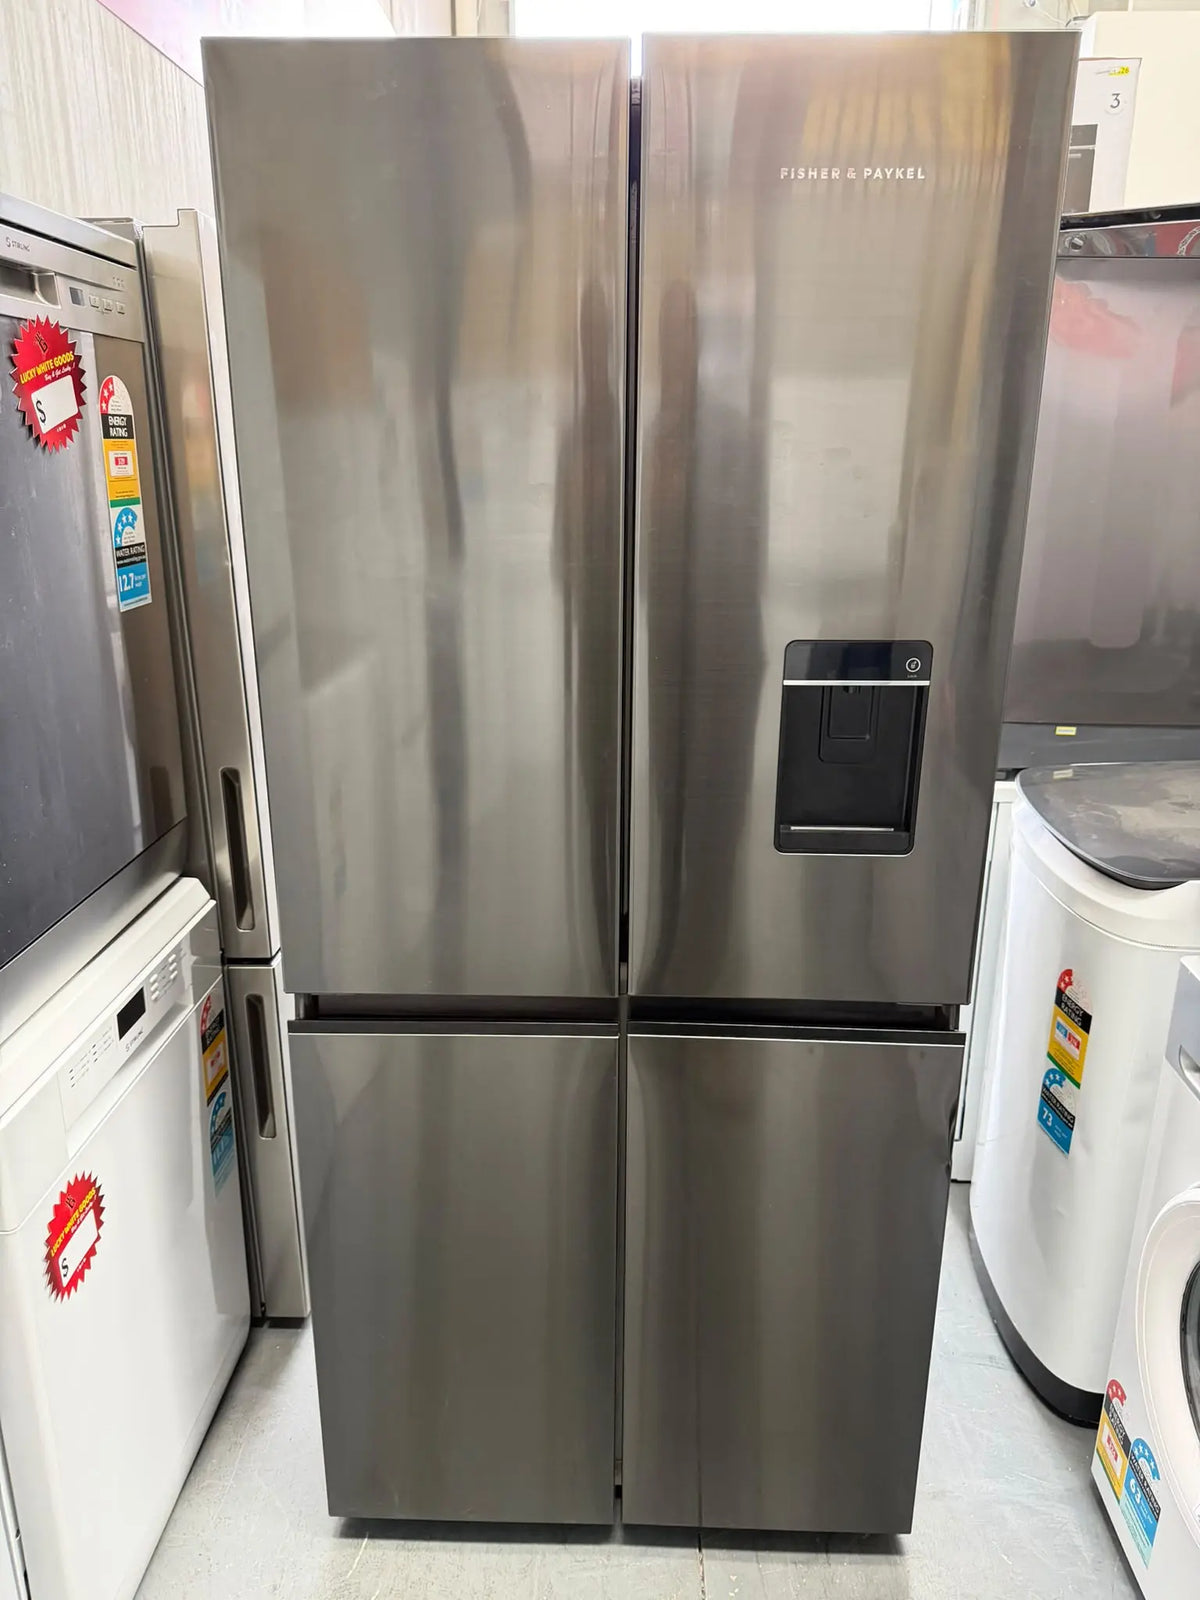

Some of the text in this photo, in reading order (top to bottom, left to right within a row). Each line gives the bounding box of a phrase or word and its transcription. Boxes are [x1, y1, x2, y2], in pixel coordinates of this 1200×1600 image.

[1110, 92, 1121, 109] 3
[780, 167, 926, 180] FISHER & PAYKEL
[19, 350, 75, 385] LUCKY WHITE GOODS
[108, 415, 127, 427] ENERGY
[109, 426, 129, 438] RATING
[116, 544, 145, 558] WATER RATING
[118, 572, 135, 593] 12.7
[1060, 1002, 1082, 1026] RATING
[1061, 993, 1084, 1017] ENERGY
[1043, 1107, 1053, 1127] 73
[1056, 1102, 1075, 1124] RATING
[50, 1230, 65, 1258] LUCKY
[64, 1208, 80, 1235] WHITE
[78, 1186, 96, 1213] GOODS
[1129, 1478, 1141, 1504] 63
